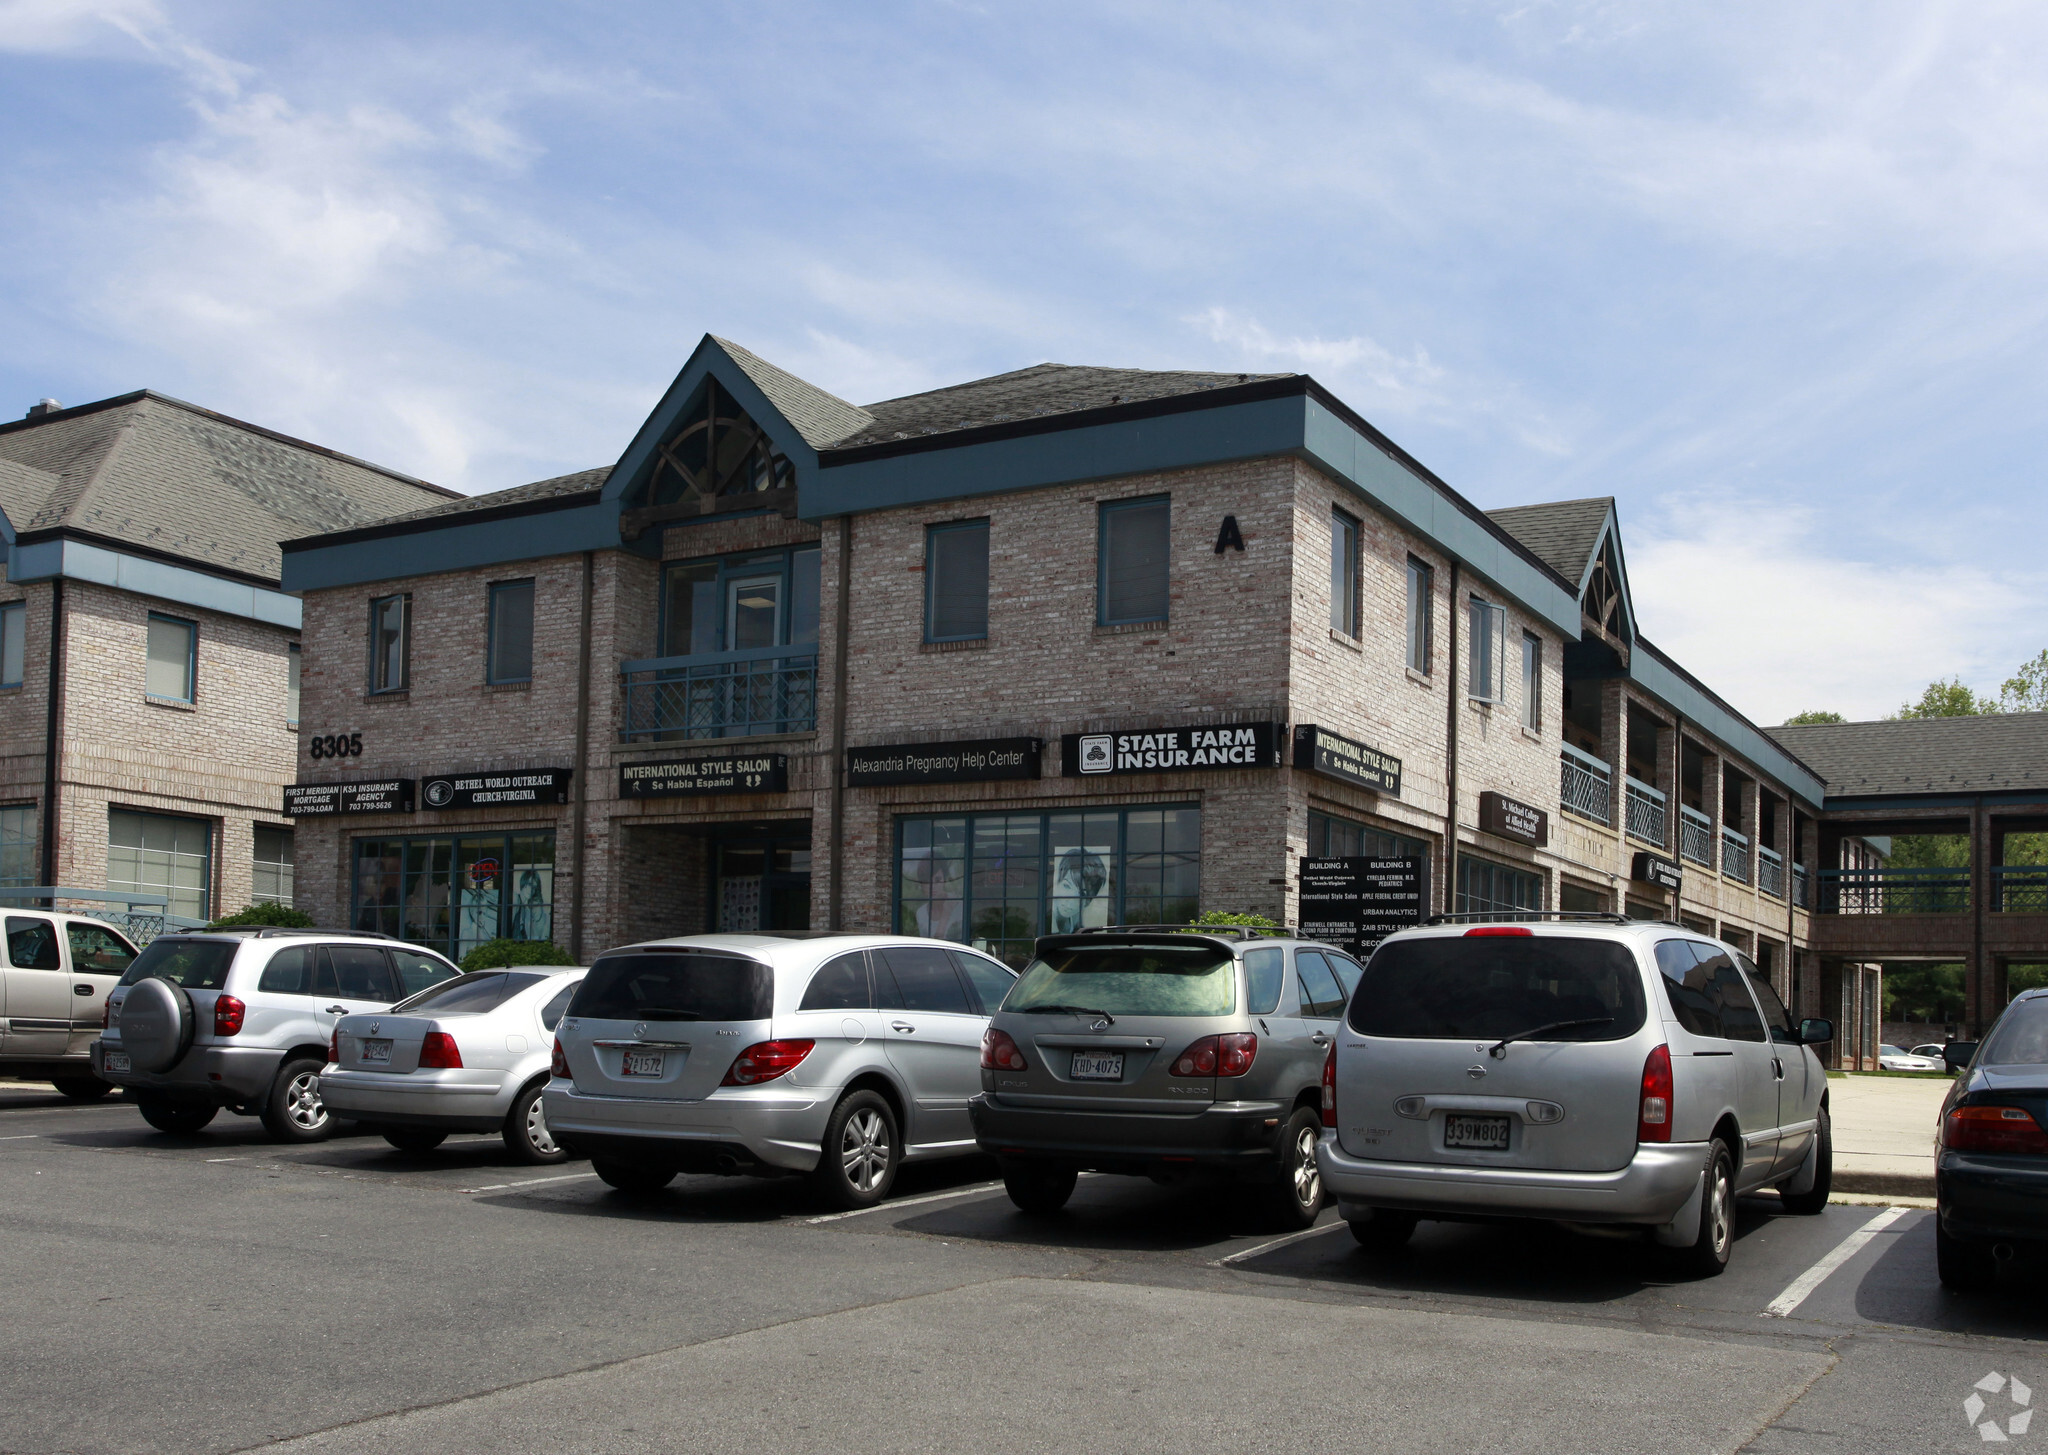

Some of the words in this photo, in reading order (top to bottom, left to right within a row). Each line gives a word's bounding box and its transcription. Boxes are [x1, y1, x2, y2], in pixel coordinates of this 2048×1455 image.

[1214, 515, 1245, 554] A
[310, 733, 363, 759] 8305
[1118, 733, 1178, 753] STATE
[1192, 728, 1256, 748] FARM
[853, 756, 904, 773] Alexandria
[906, 754, 960, 774] Pregnancy
[962, 752, 986, 770] Help
[988, 750, 1024, 766] Center
[1117, 746, 1256, 769] INSURANCE
[1316, 731, 1361, 762] INTERNATIONAL
[1362, 749, 1380, 769] STYLE
[1381, 757, 1399, 776] SALON
[623, 764, 698, 780] INTERNATIONAL
[701, 762, 733, 775] STYLE
[736, 759, 771, 773] SALON
[1334, 756, 1342, 768] Se
[1342, 760, 1359, 775] Habla
[1359, 766, 1380, 782] Español
[286, 788, 305, 796] FIRST
[306, 785, 339, 796] MERIDIAN
[343, 785, 357, 793] KSA
[359, 782, 400, 793] INSURANCE
[455, 779, 484, 790] BETHEL
[486, 777, 511, 788] WORLD
[513, 775, 553, 787] OUTREACH
[652, 780, 664, 790] Se
[667, 779, 693, 789] Habla
[696, 777, 734, 789] Español
[294, 795, 331, 805] MORTGAGE
[356, 792, 386, 802] AGENCY
[472, 790, 536, 803] CHURCH-VIRGINIA
[290, 804, 334, 813] 703-799-LOAN
[349, 803, 361, 811] 703
[362, 801, 393, 810] 799-5626
[1508, 802, 1525, 817] Michael
[1524, 808, 1540, 825] College
[1505, 813, 1511, 824] of
[1511, 815, 1523, 828] Allied
[1523, 819, 1537, 833] Health
[1073, 1059, 1121, 1074] KHD-4075
[1448, 1123, 1507, 1141] 339M802
